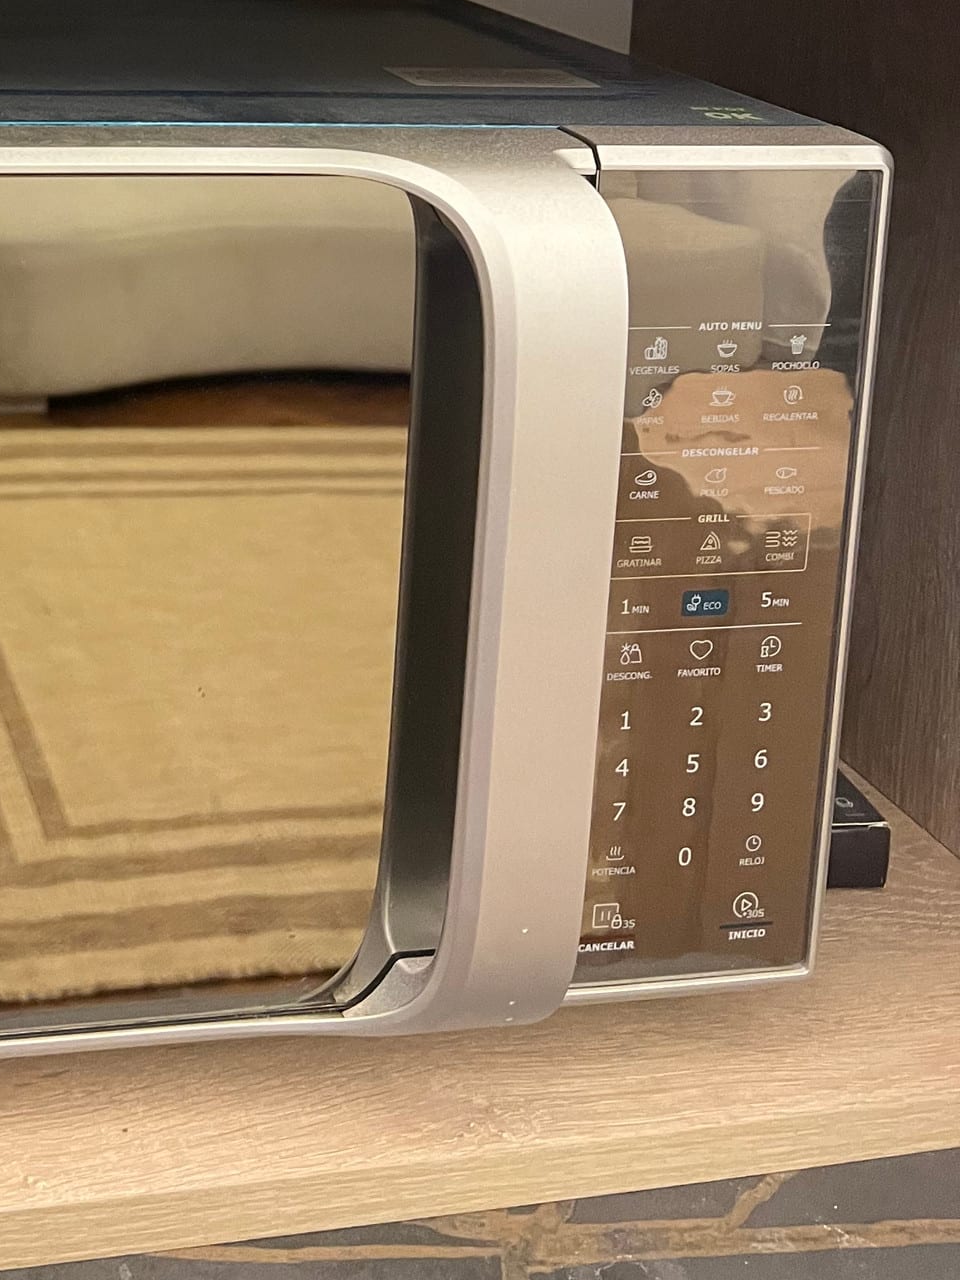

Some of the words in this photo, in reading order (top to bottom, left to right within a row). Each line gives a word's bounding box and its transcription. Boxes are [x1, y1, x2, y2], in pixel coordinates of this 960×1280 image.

[698, 322, 729, 331] AUTO
[731, 321, 763, 331] MENU
[629, 365, 680, 376] VEGETALES
[710, 364, 740, 373] SOPAS
[771, 360, 820, 370] POCHOCLO
[701, 414, 740, 424] BEBIDAS
[763, 411, 818, 422] RECALENTAR
[681, 446, 759, 458] DESCONGELAR
[629, 490, 660, 500] CARNE
[699, 487, 729, 497] POLLO
[764, 485, 805, 495] PESCADO
[697, 514, 730, 523] GRILL
[695, 555, 722, 565] PIZZA
[765, 552, 794, 562] COMBI
[616, 558, 662, 568] GRATINAR
[703, 600, 722, 611] ECO
[677, 667, 722, 678] FAVORITO
[756, 663, 784, 673] TIMER
[606, 672, 654, 682] DESCONG.
[690, 707, 704, 726] 2
[758, 703, 772, 722] 3
[620, 711, 631, 730] 1
[686, 754, 700, 773] 5
[754, 749, 768, 769] 6
[615, 758, 629, 777] 4
[682, 798, 696, 817] 8
[751, 793, 764, 812] 9
[612, 802, 626, 821] 7
[678, 847, 692, 866] 0
[739, 856, 765, 866] RELOJ
[591, 866, 636, 876] POTENCIA
[728, 928, 766, 940] INICIO
[577, 941, 635, 953] CANCELAR
